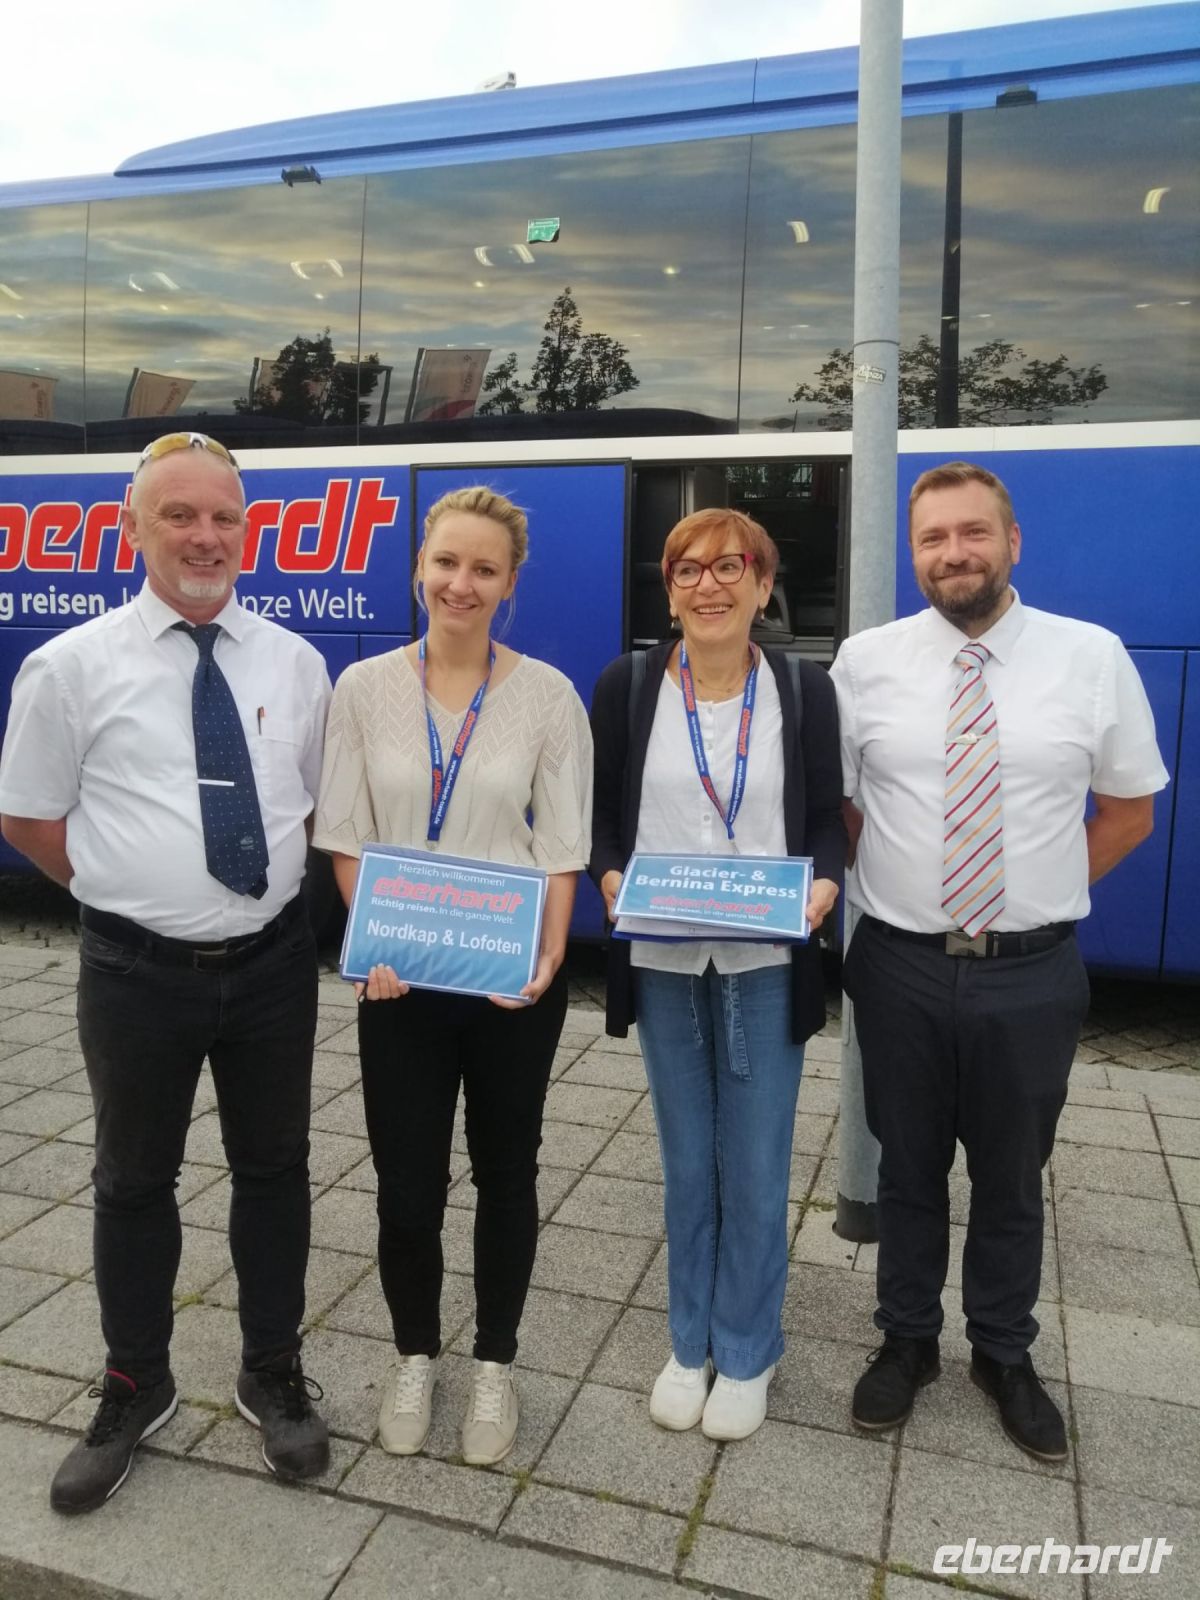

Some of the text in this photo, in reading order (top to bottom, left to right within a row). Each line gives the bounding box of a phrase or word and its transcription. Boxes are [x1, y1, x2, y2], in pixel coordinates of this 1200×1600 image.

[21, 585, 116, 616] reisen.
[297, 587, 375, 620] Welt.
[398, 863, 505, 887] Herzlich willkommen!
[670, 865, 766, 881] Glacier- &
[373, 875, 524, 913] eberhardt
[635, 874, 797, 898] Bernina Express
[371, 896, 405, 911] Richtig
[406, 902, 438, 914] reisen.
[439, 907, 447, 915] In
[450, 908, 463, 918] die
[465, 911, 492, 921] ganze
[367, 918, 522, 955] Nordkap & Lofoten
